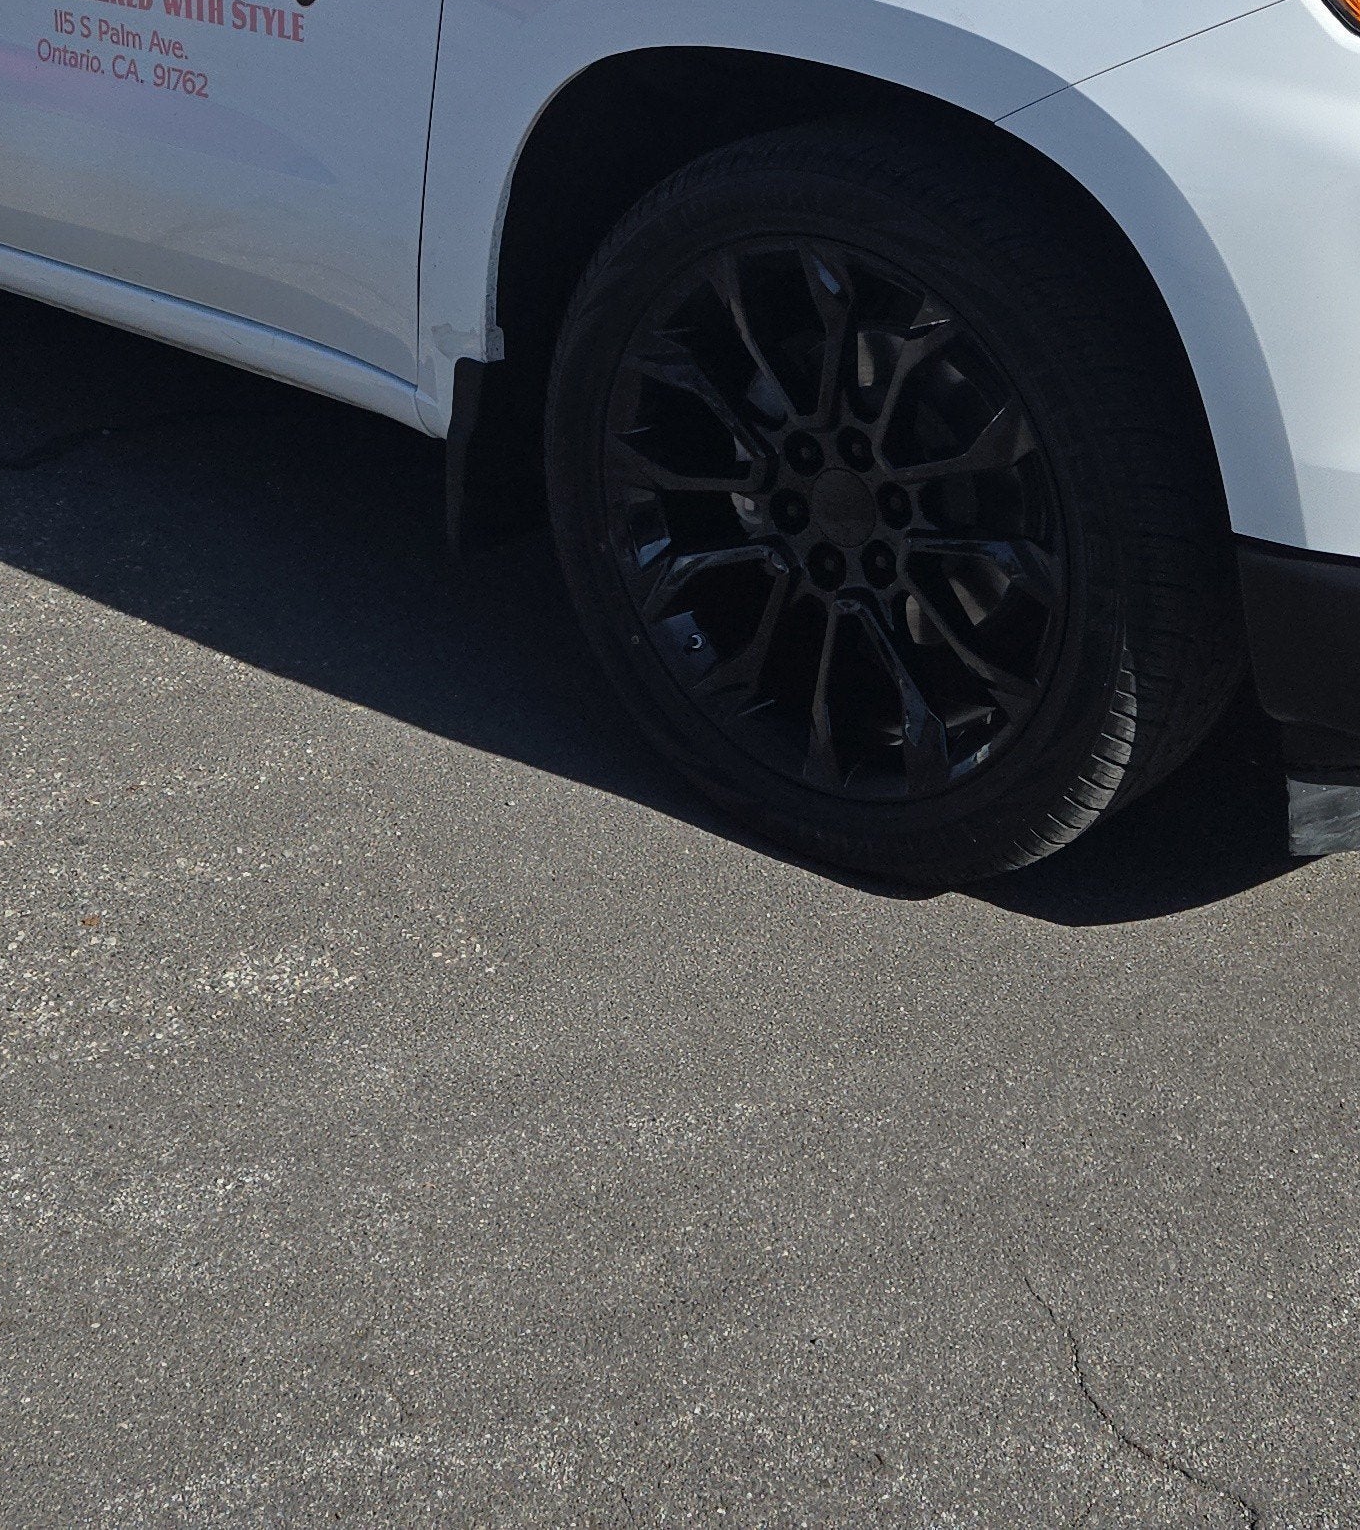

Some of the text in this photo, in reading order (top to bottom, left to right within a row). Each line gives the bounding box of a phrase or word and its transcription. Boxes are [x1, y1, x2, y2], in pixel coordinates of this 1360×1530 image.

[53, 8, 189, 60] 115 S Palm Ave.
[232, 0, 306, 43] STYLE
[153, 63, 209, 99] 91762
